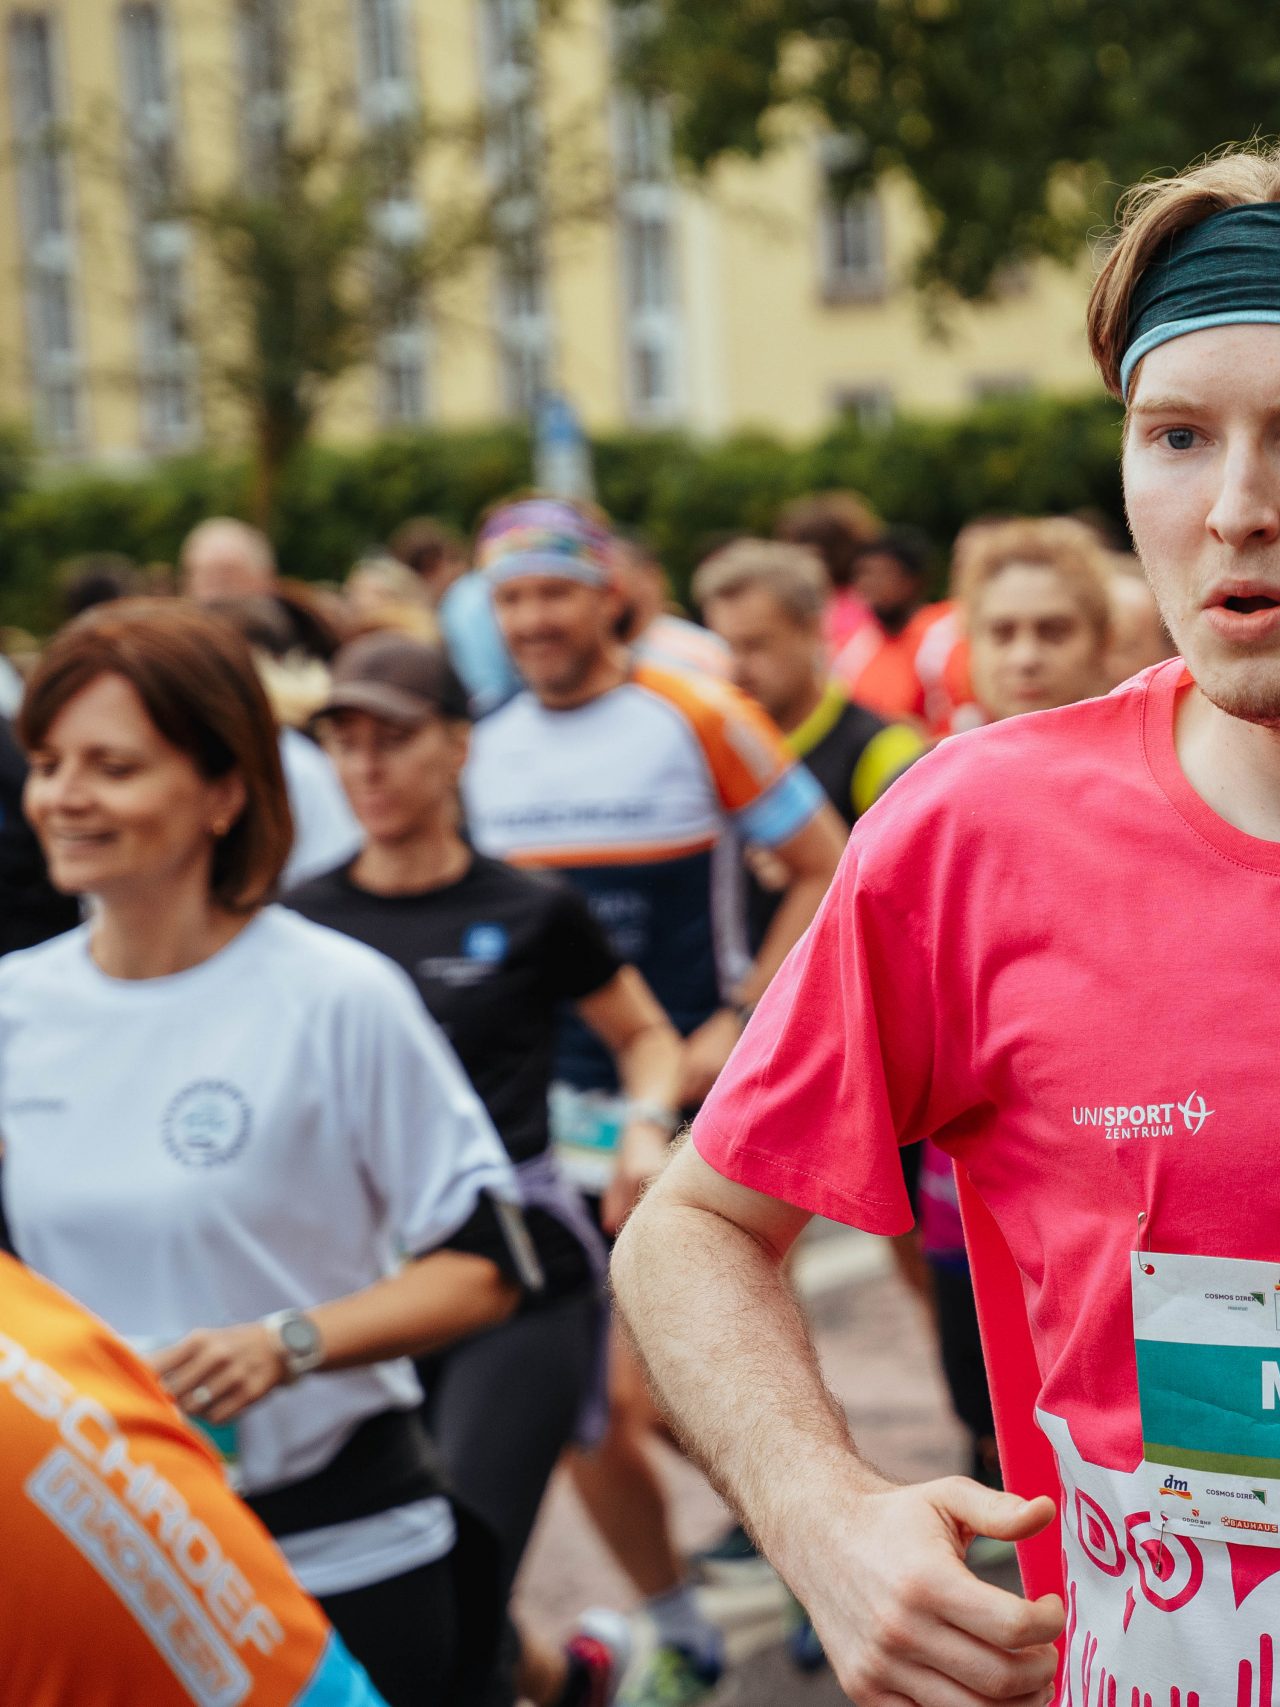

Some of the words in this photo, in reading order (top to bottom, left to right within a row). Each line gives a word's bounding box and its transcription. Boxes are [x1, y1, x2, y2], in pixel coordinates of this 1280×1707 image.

[1072, 1103, 1175, 1127] UNISPORT
[1105, 1125, 1173, 1140] ZENTRUM
[1204, 1293, 1234, 1301] COSMOS
[1163, 1474, 1188, 1491] dm
[1205, 1488, 1235, 1498] COSMOS
[1230, 1519, 1278, 1533] BAUHAUS
